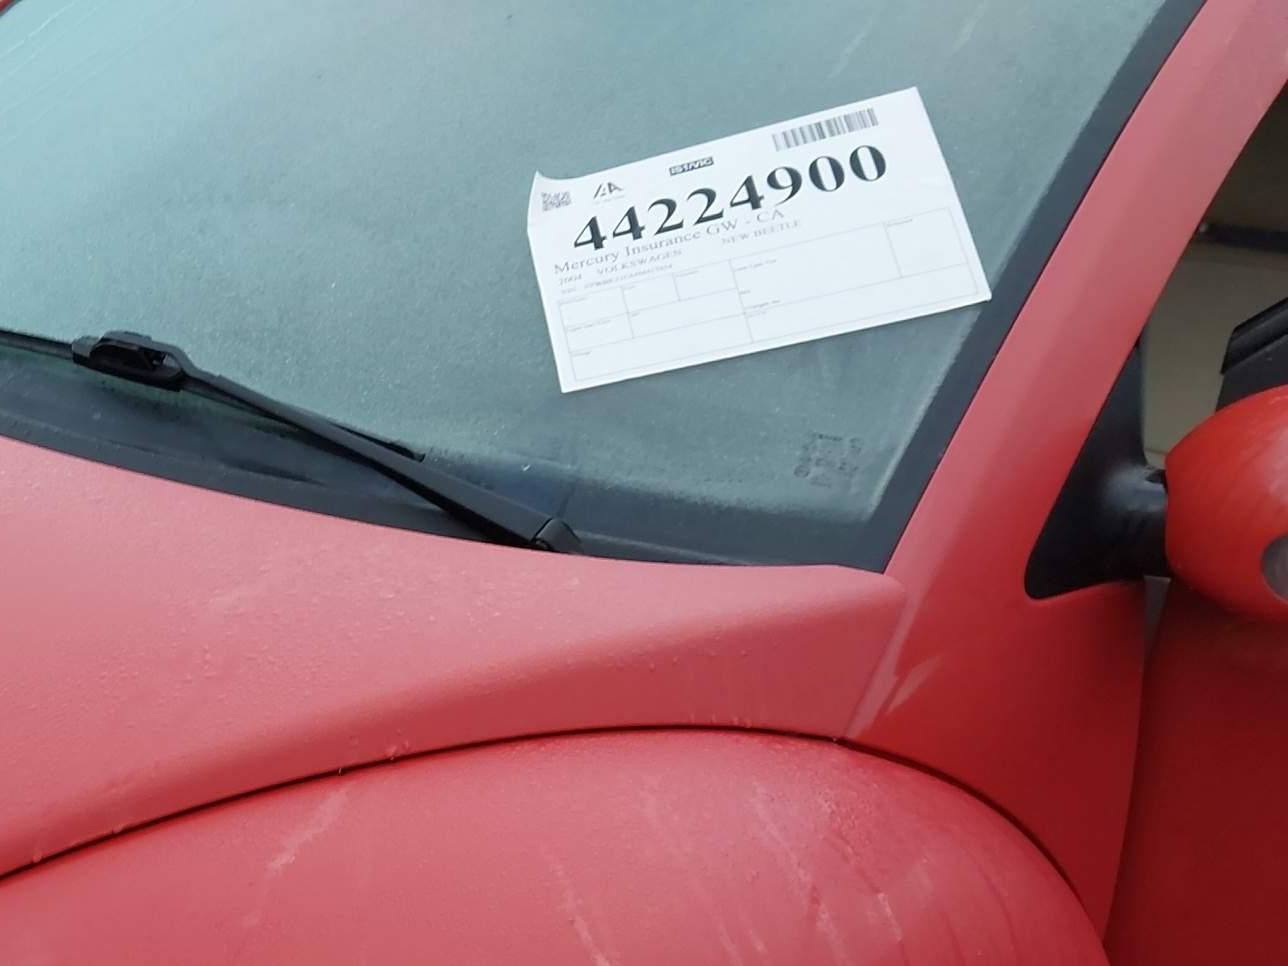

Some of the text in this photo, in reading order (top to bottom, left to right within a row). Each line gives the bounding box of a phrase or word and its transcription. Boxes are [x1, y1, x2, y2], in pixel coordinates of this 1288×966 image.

[573, 145, 887, 251] 44224900
[554, 251, 619, 275] Mercury
[625, 230, 702, 257] Insurance
[706, 217, 738, 236] GW
[756, 208, 785, 223] CA
